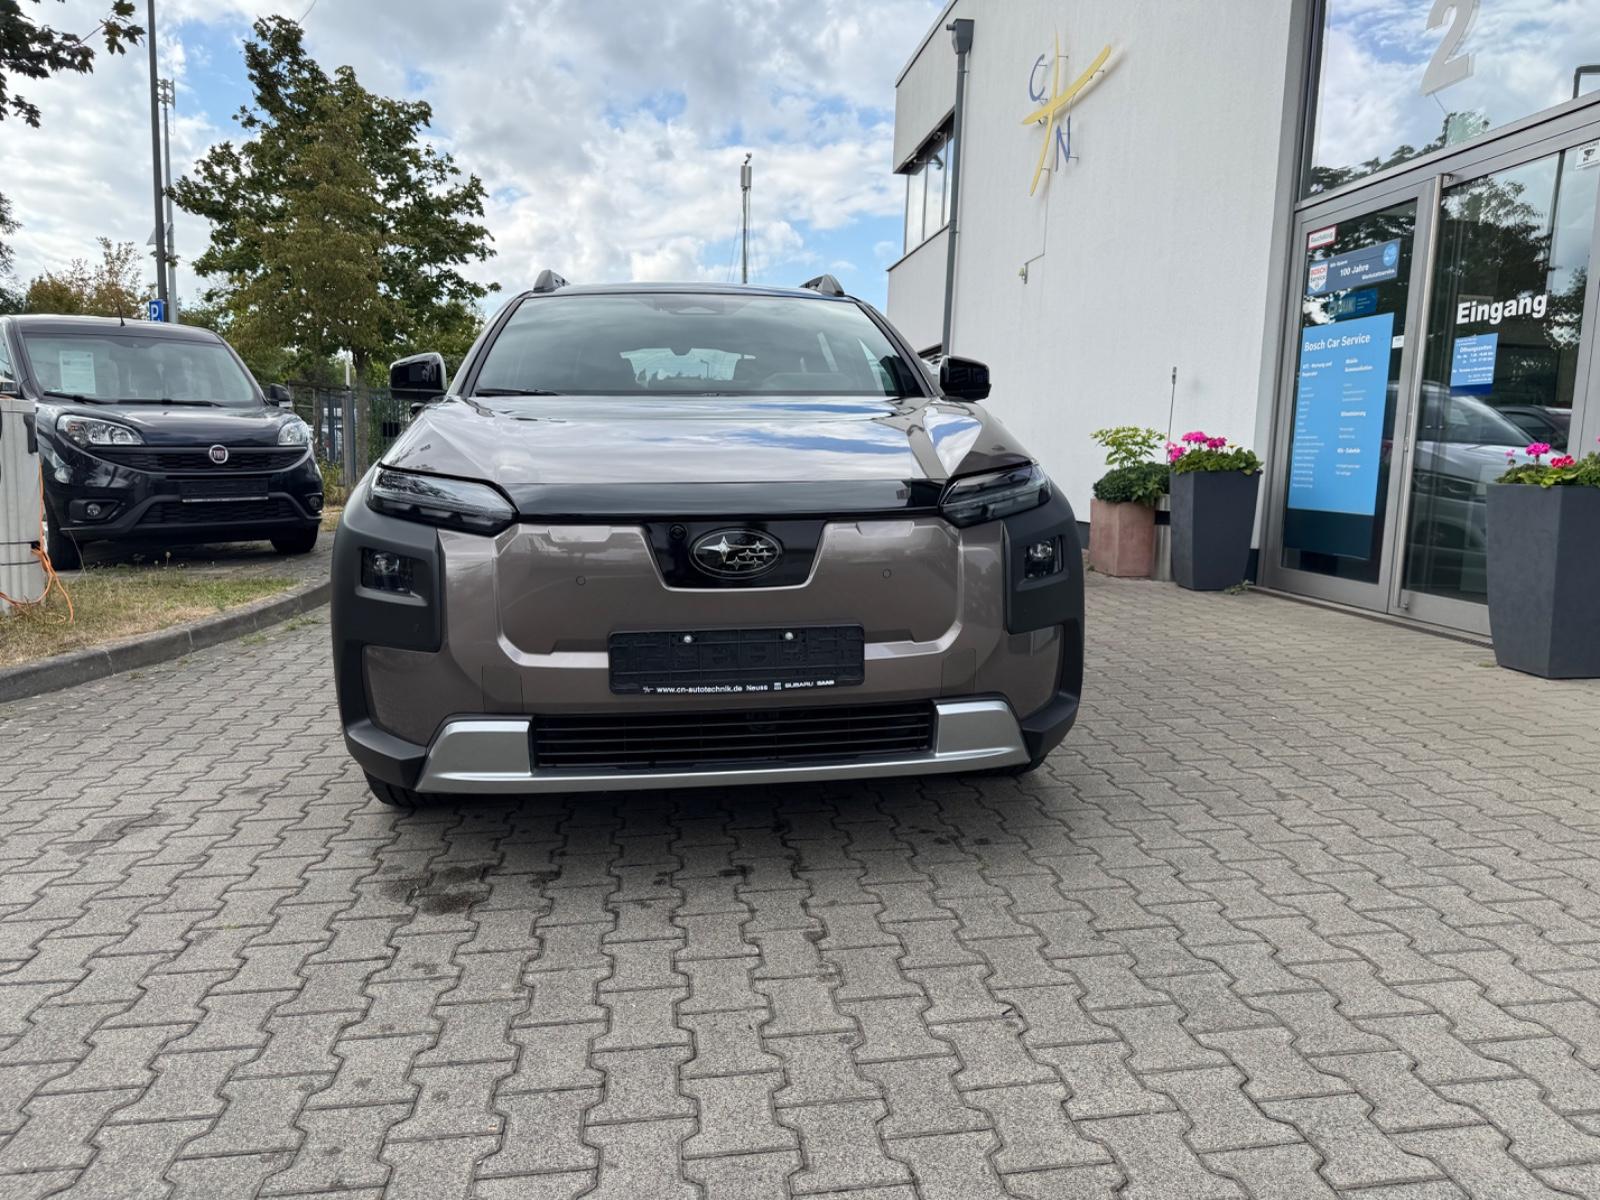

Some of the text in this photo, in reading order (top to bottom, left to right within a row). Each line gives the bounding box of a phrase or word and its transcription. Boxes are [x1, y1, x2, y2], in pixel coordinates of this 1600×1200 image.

[1419, 0, 1475, 97] 2
[1029, 53, 1046, 102] C
[1055, 114, 1072, 173] N
[1340, 267, 1351, 277] 100
[1351, 264, 1370, 275] Jahre
[150, 303, 159, 320] P
[1456, 294, 1548, 325] Eingang
[1304, 332, 1371, 352] Bosch Car Service
[656, 685, 743, 694] www.cn-autotechnik.de
[746, 684, 768, 692] Neuss
